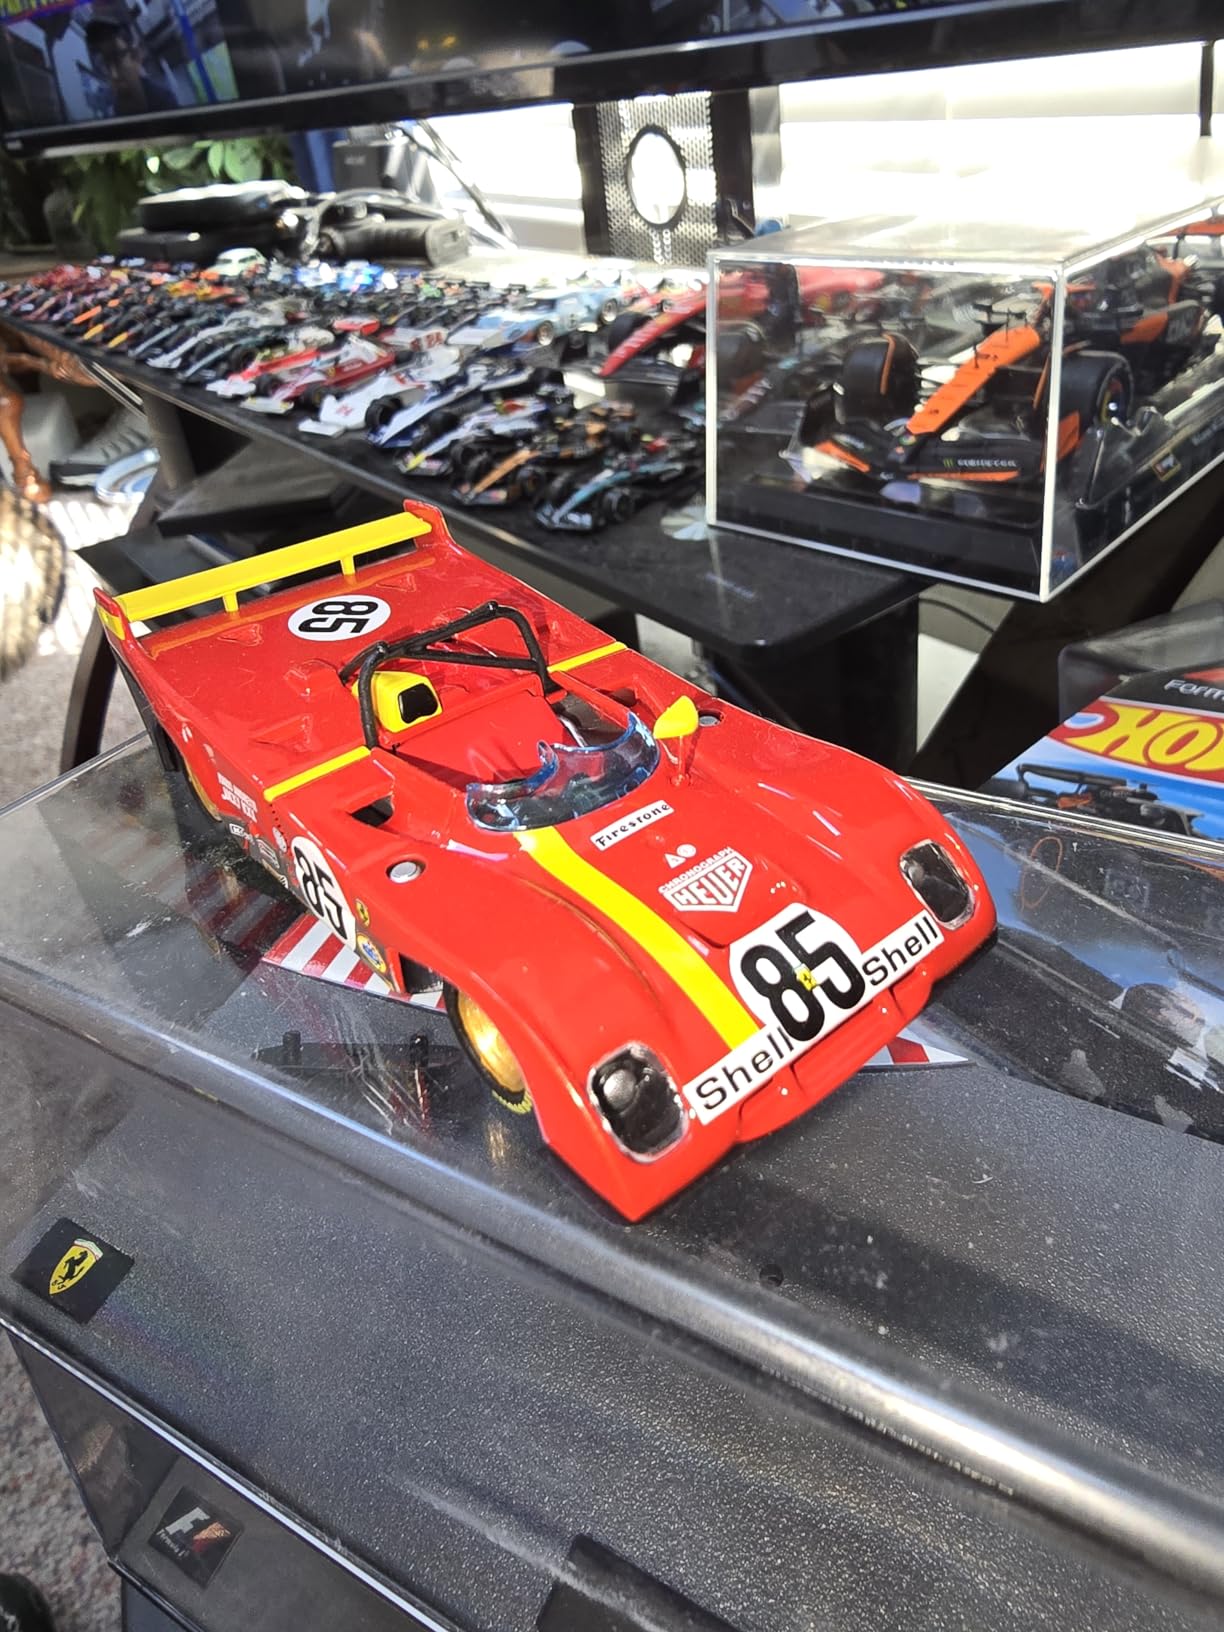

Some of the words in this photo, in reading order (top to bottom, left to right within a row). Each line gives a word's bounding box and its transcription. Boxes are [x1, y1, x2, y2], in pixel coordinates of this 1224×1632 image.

[298, 601, 379, 633] 85
[595, 802, 671, 847] Firestone
[293, 845, 348, 941] 85
[659, 845, 735, 894] CHRONOGRAPH
[673, 857, 746, 906] HEUER
[740, 911, 866, 1042] 85
[863, 916, 938, 987] Shell
[695, 1026, 795, 1111] Shell
